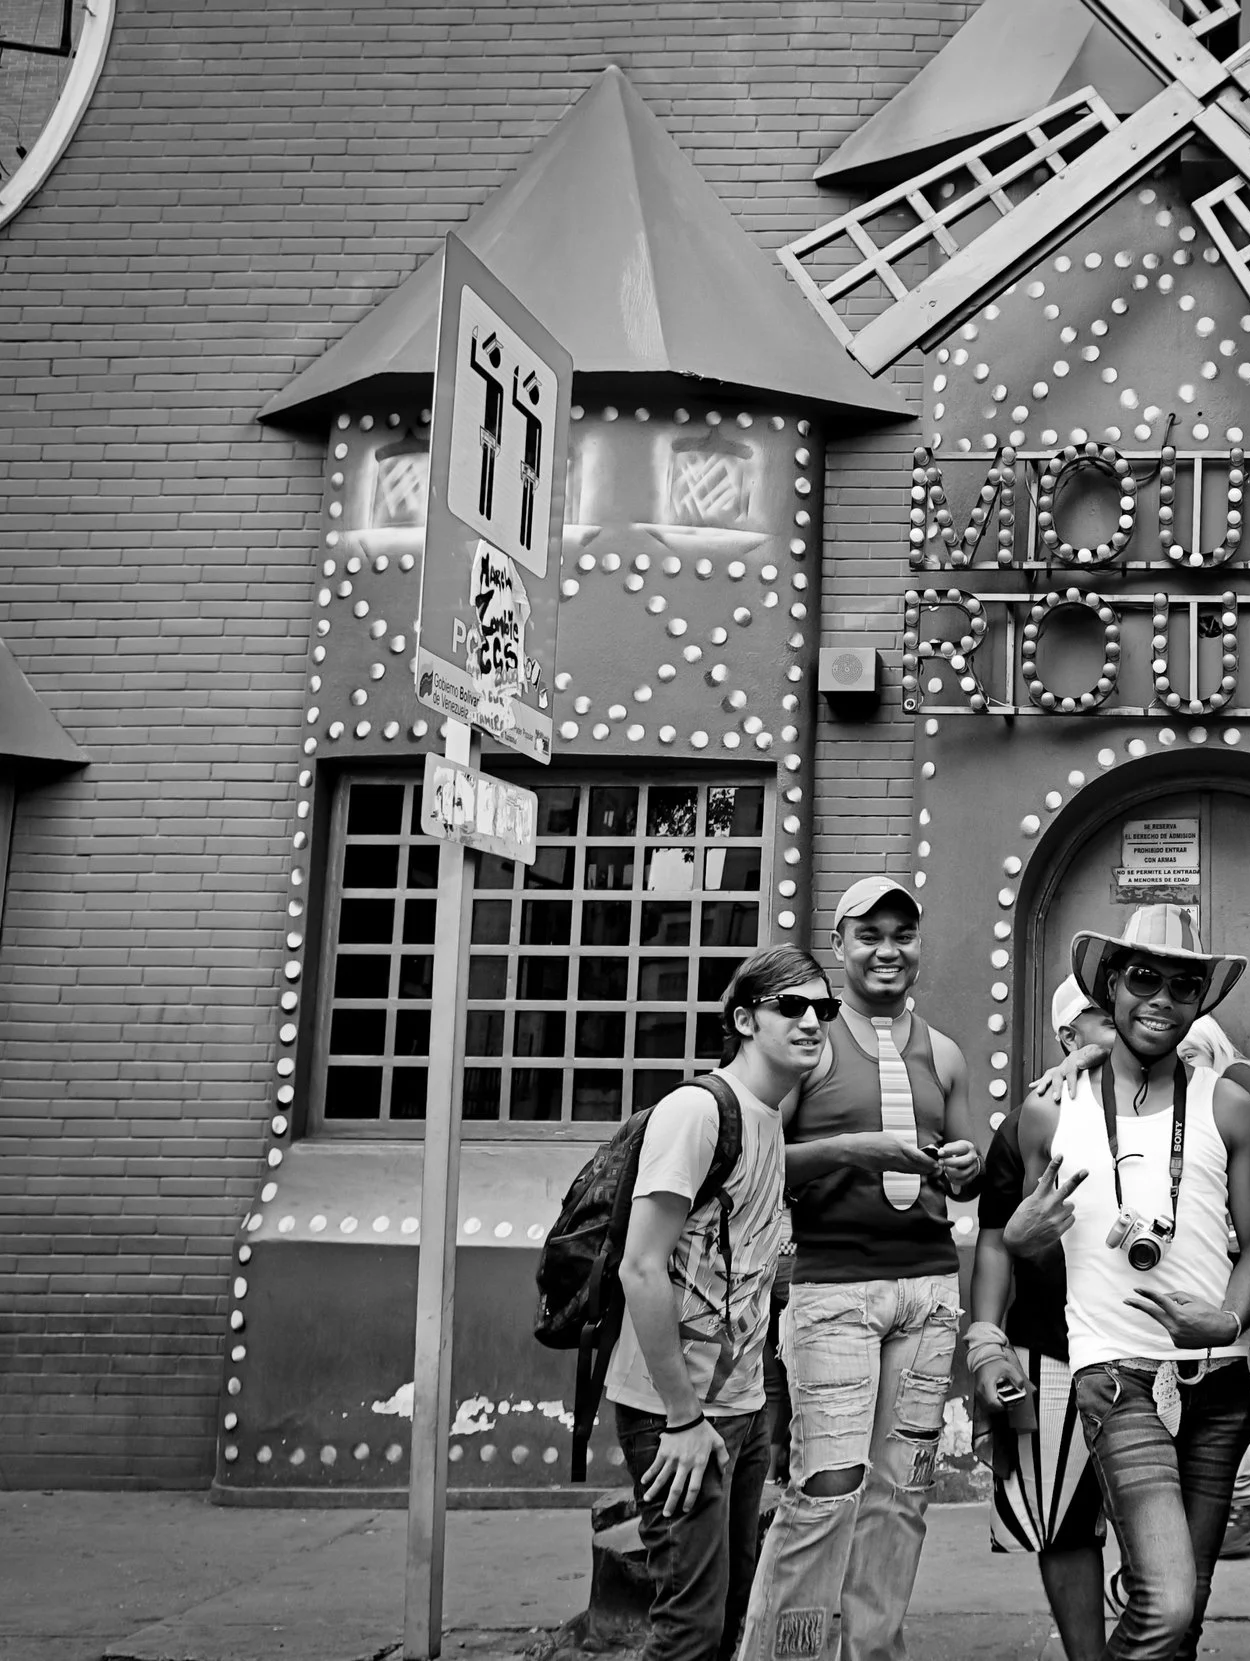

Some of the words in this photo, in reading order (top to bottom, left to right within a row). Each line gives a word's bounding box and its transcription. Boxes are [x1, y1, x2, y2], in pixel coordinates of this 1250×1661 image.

[481, 636, 518, 674] CCS
[433, 672, 459, 698] Gobierno
[433, 690, 440, 706] de
[442, 693, 469, 719] Venezuela
[1174, 1120, 1183, 1152] SONY
